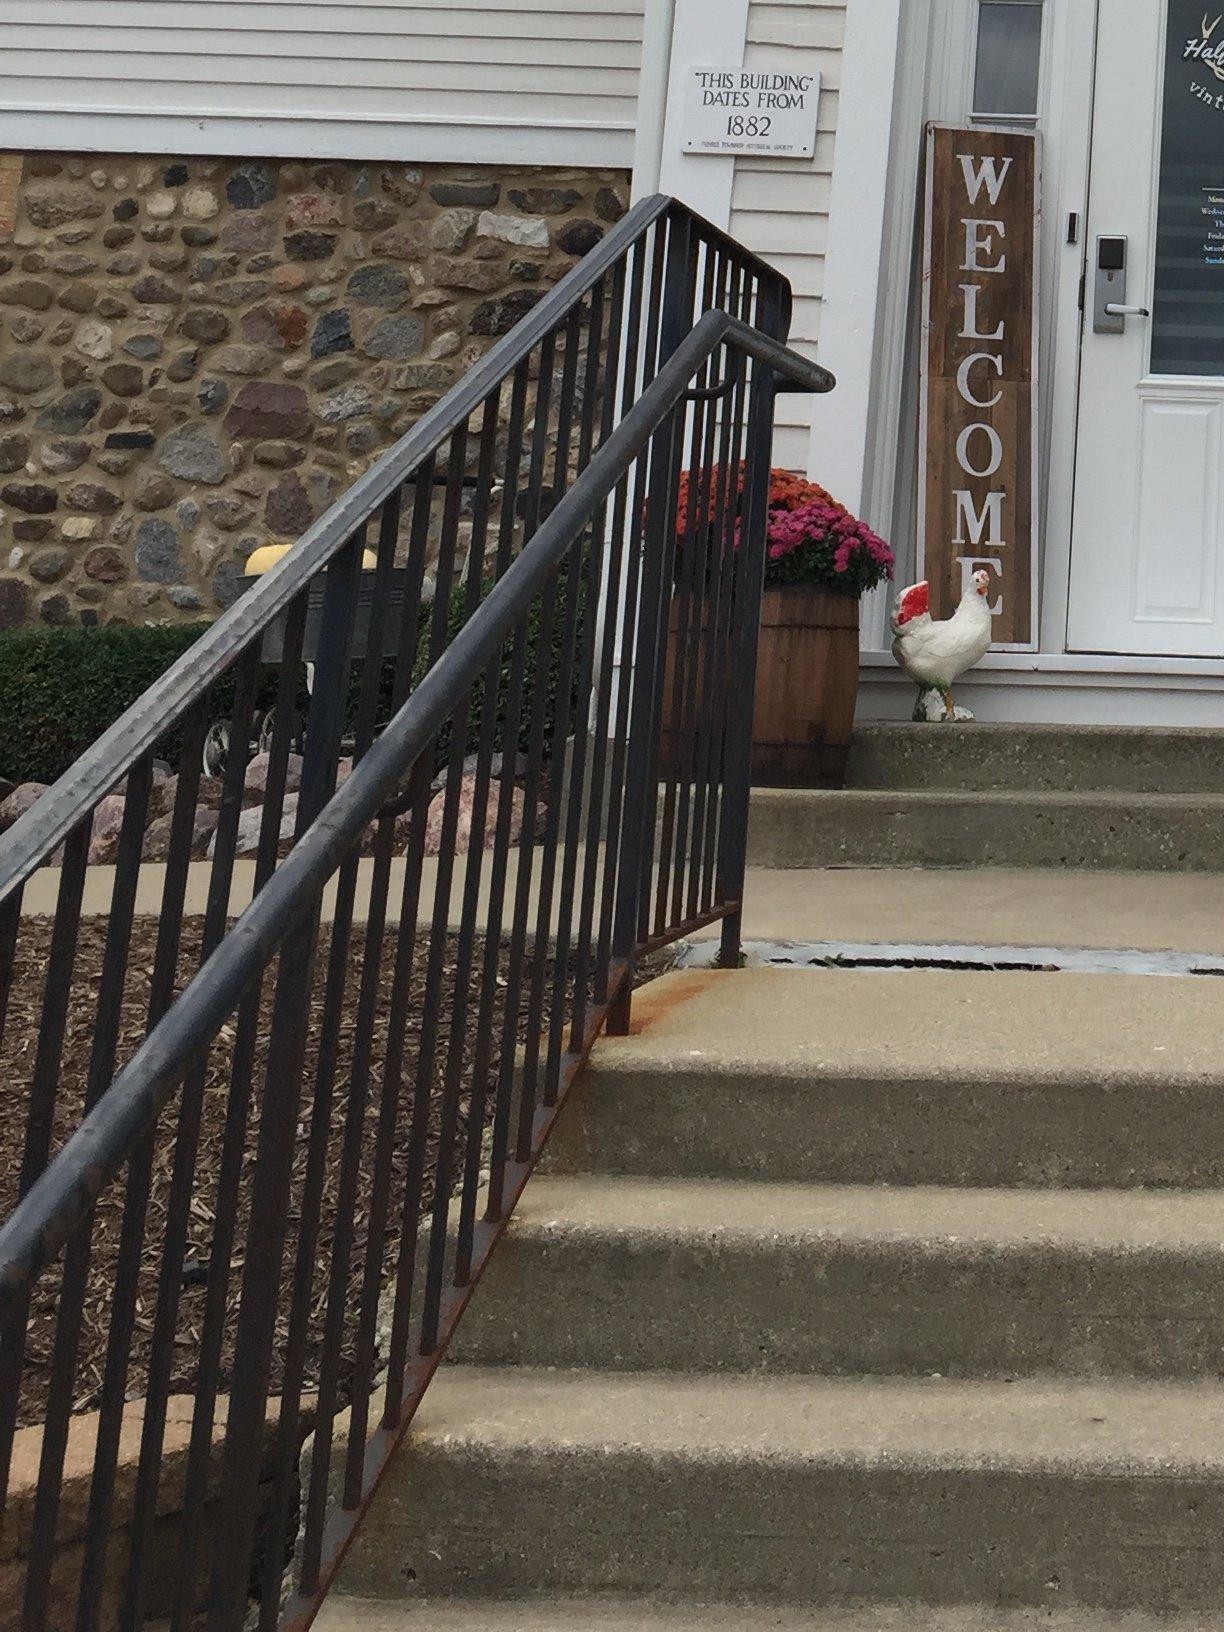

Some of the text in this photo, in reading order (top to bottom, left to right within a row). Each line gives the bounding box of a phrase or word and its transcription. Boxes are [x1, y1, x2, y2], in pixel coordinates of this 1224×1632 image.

[700, 72, 810, 92] THIS BUILDING
[702, 90, 805, 110] DATES FROM
[726, 115, 772, 137] 1882
[951, 154, 1013, 616] WELCOME
